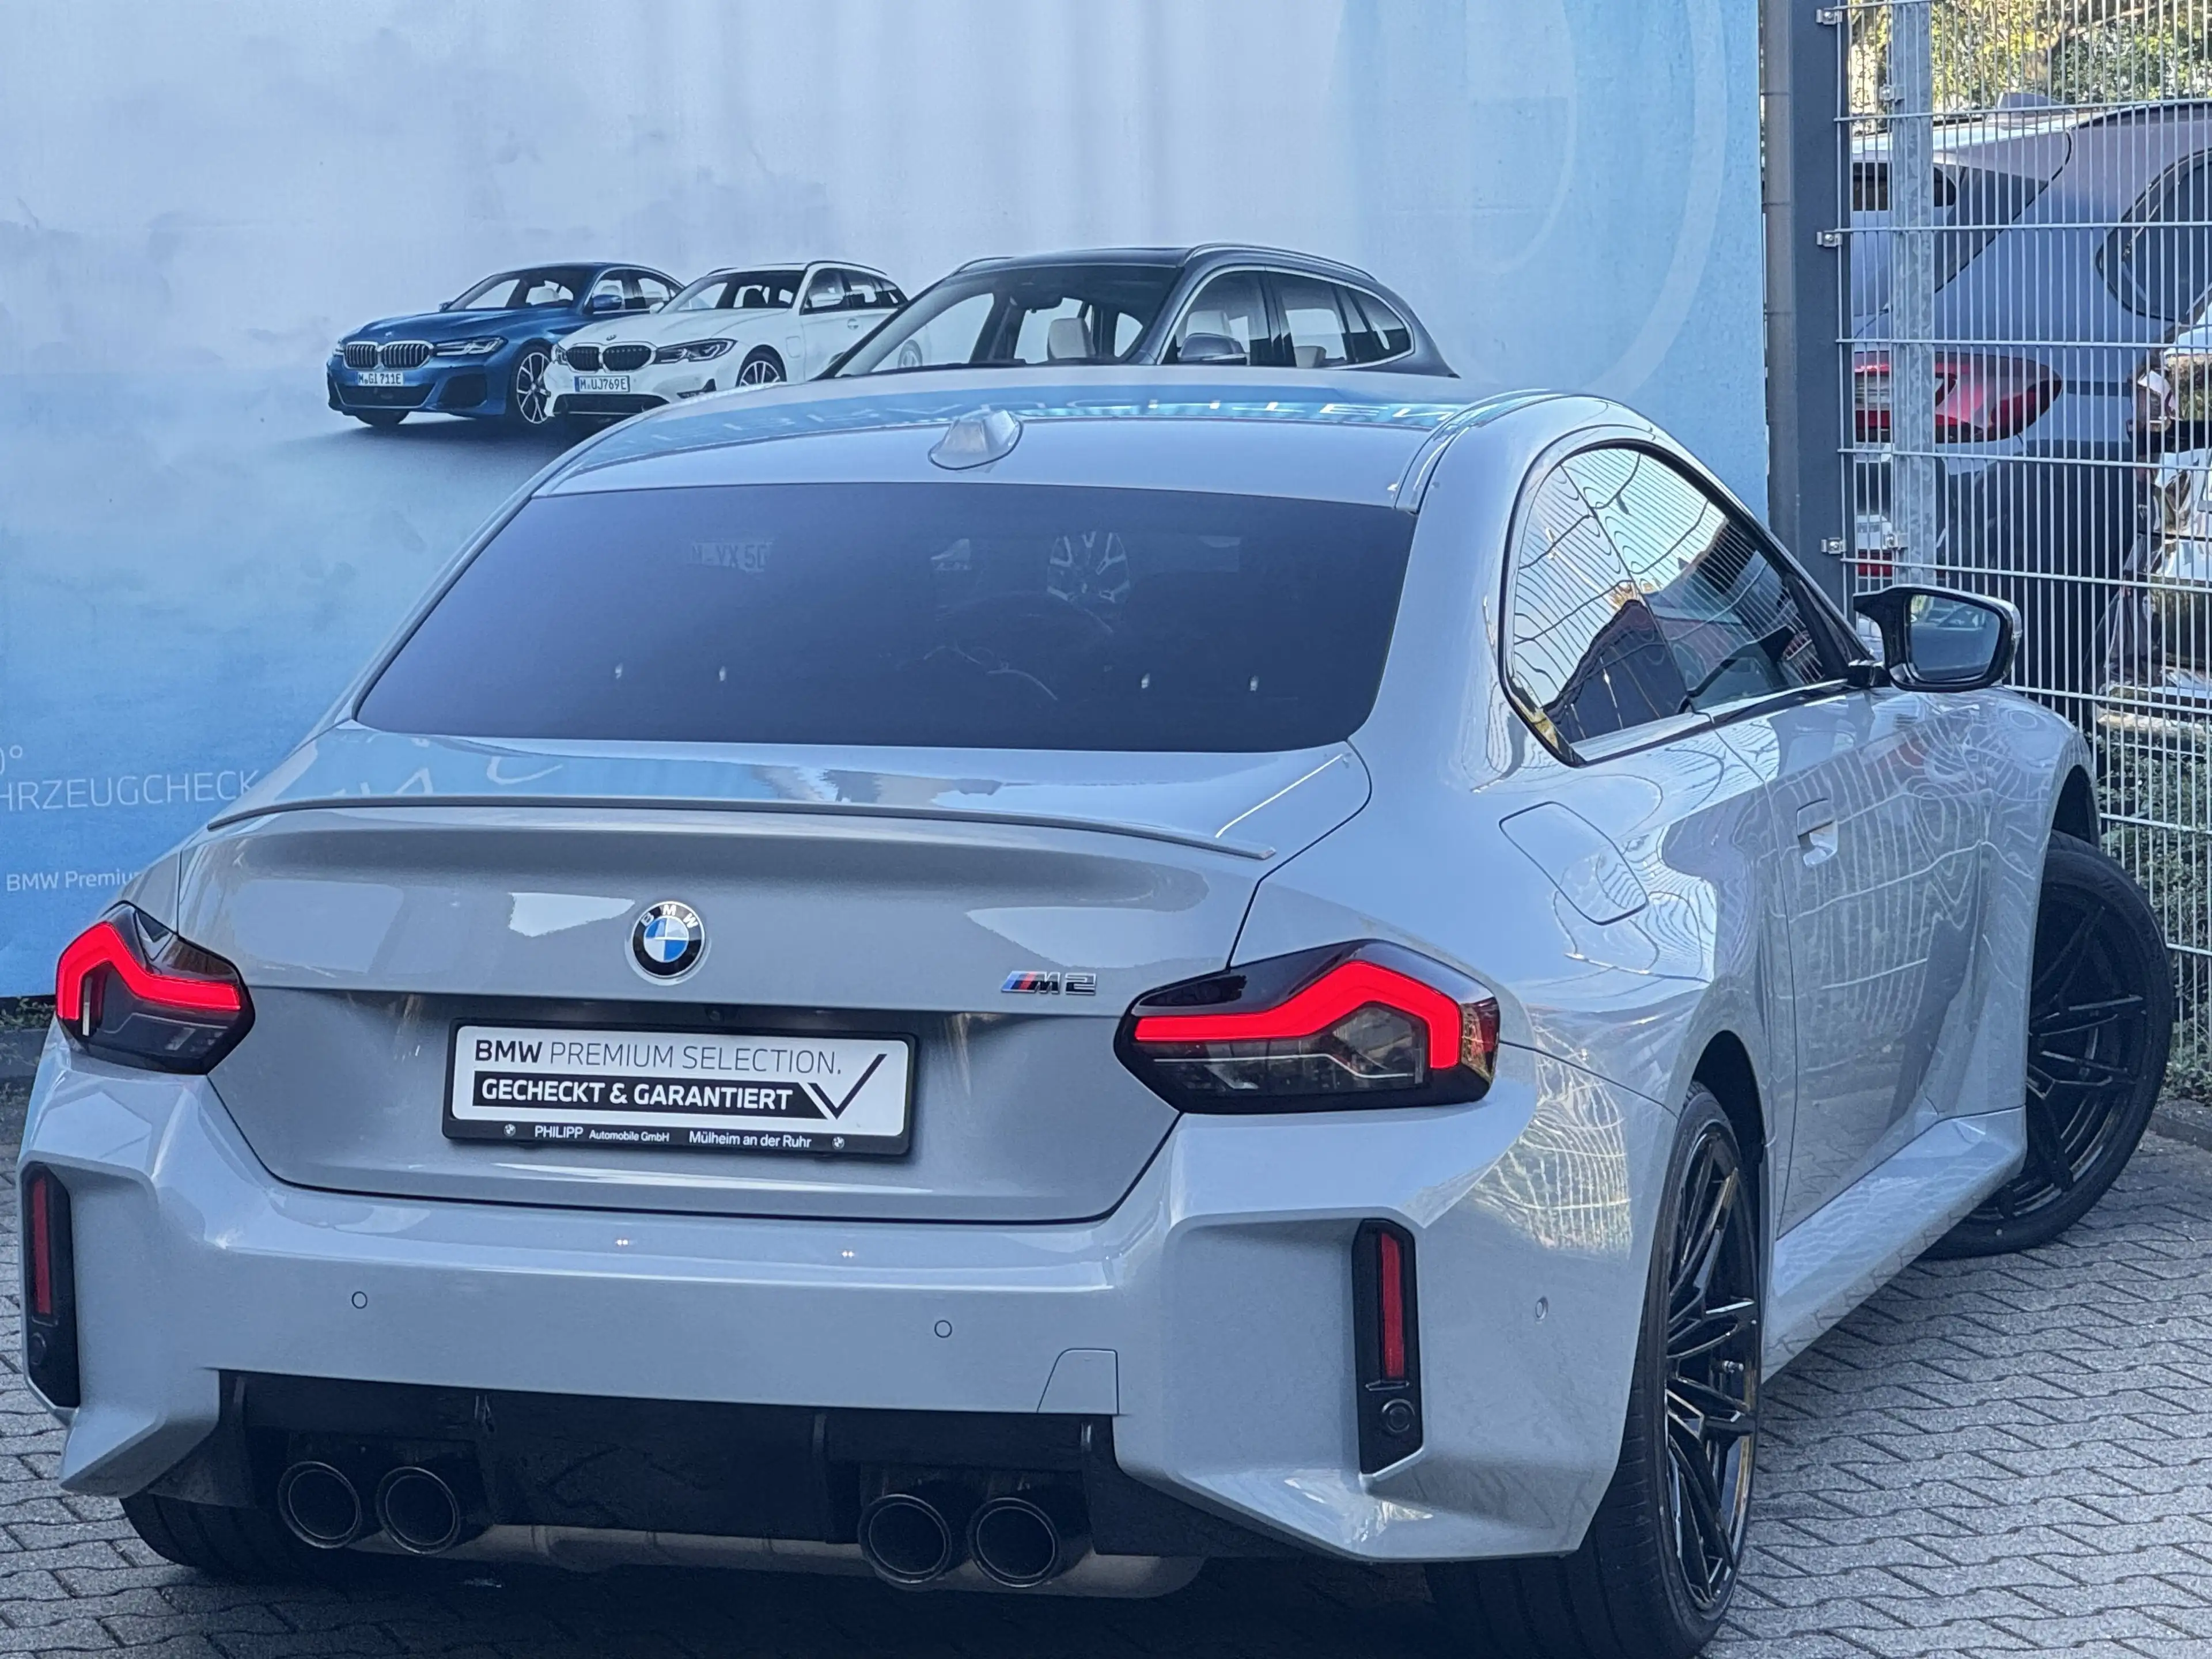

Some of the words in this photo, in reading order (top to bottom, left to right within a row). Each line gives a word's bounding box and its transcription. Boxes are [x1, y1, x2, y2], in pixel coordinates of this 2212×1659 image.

[6, 872, 59, 892] BMW
[65, 868, 142, 888] Premiu
[1001, 970, 1097, 996] M2
[475, 1039, 543, 1063] BMW
[551, 1041, 673, 1069] PREMIUM
[682, 1046, 842, 1075] SELECTION.
[482, 1078, 606, 1104] GECHECKT
[609, 1082, 628, 1105] &
[634, 1084, 794, 1111] GARANTIERT
[534, 1125, 584, 1139] PHILIPP
[589, 1129, 639, 1142] Automobile
[641, 1131, 670, 1143] GmbH
[689, 1130, 740, 1145] Mülheim
[743, 1135, 757, 1146] an
[760, 1134, 781, 1147] der
[782, 1134, 812, 1149] Ruhr
